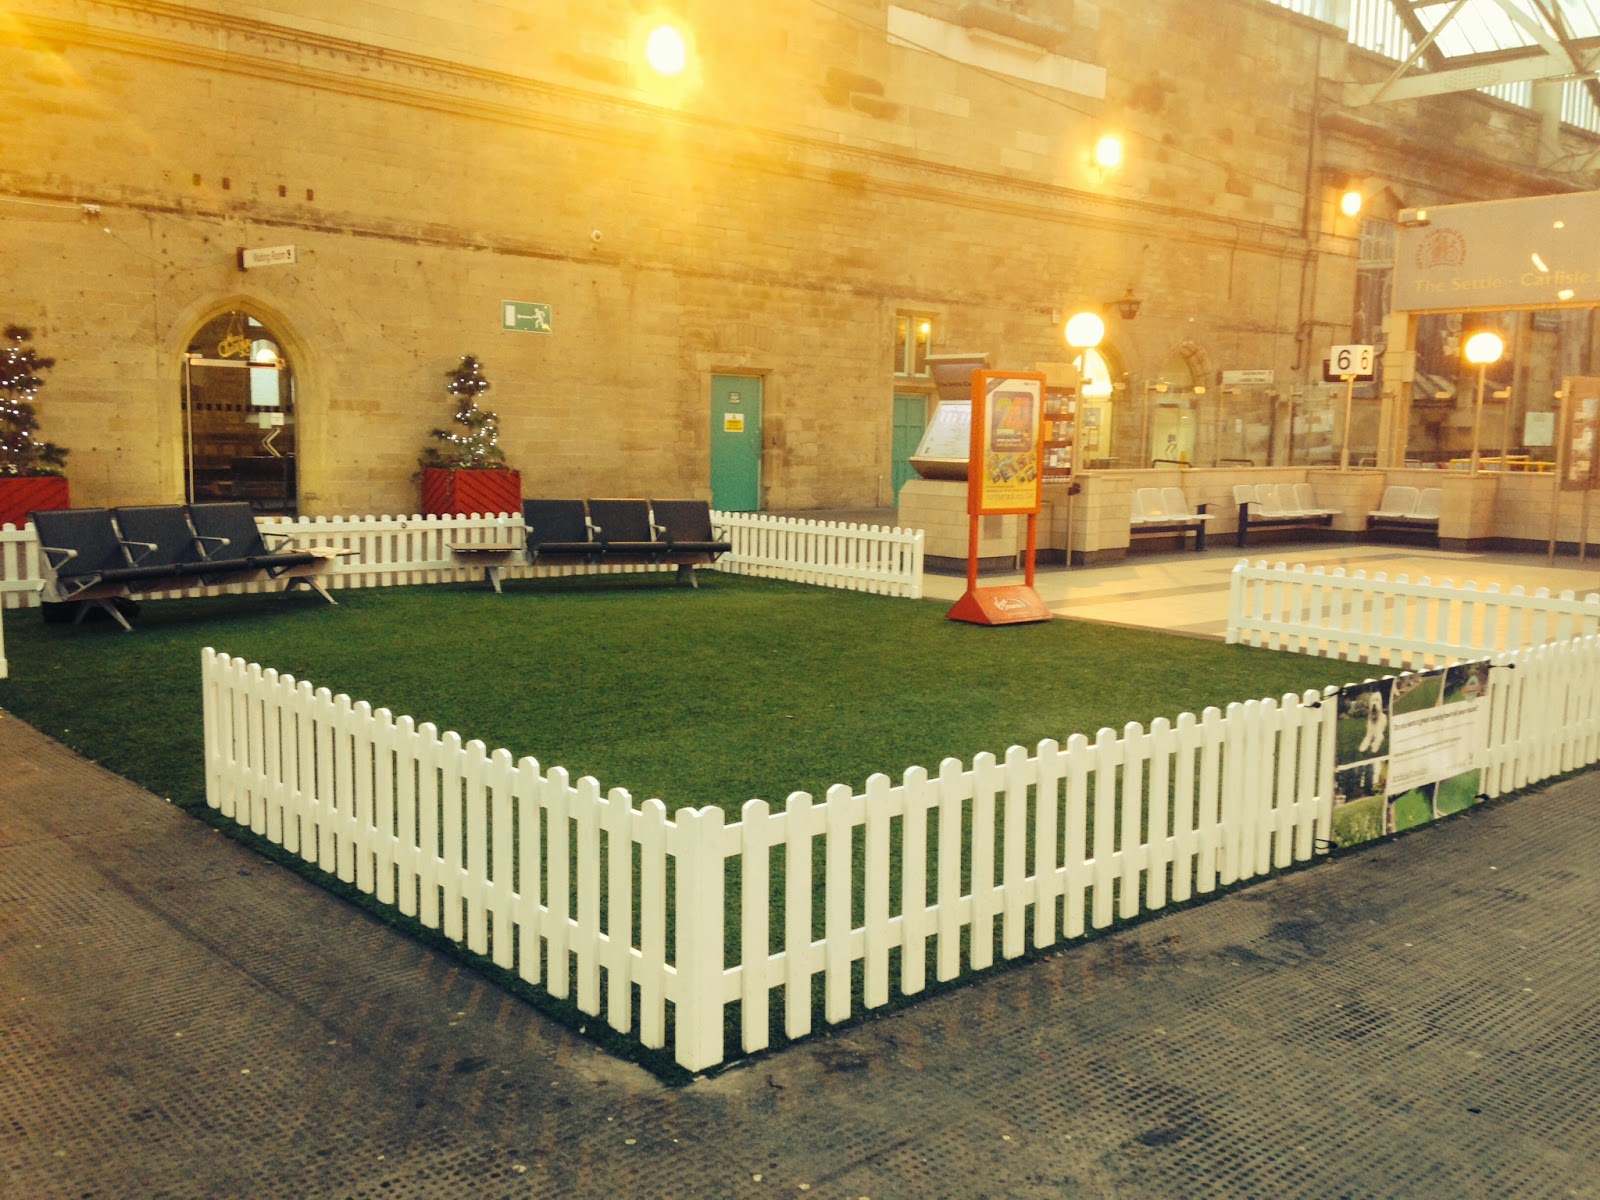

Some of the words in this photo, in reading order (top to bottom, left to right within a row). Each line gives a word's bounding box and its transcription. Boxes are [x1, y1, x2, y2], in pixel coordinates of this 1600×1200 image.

[1414, 279, 1445, 293] The
[1451, 275, 1502, 291] Settle
[1520, 269, 1592, 287] Carlisle
[1338, 349, 1351, 370] 6
[1360, 349, 1370, 370] 6
